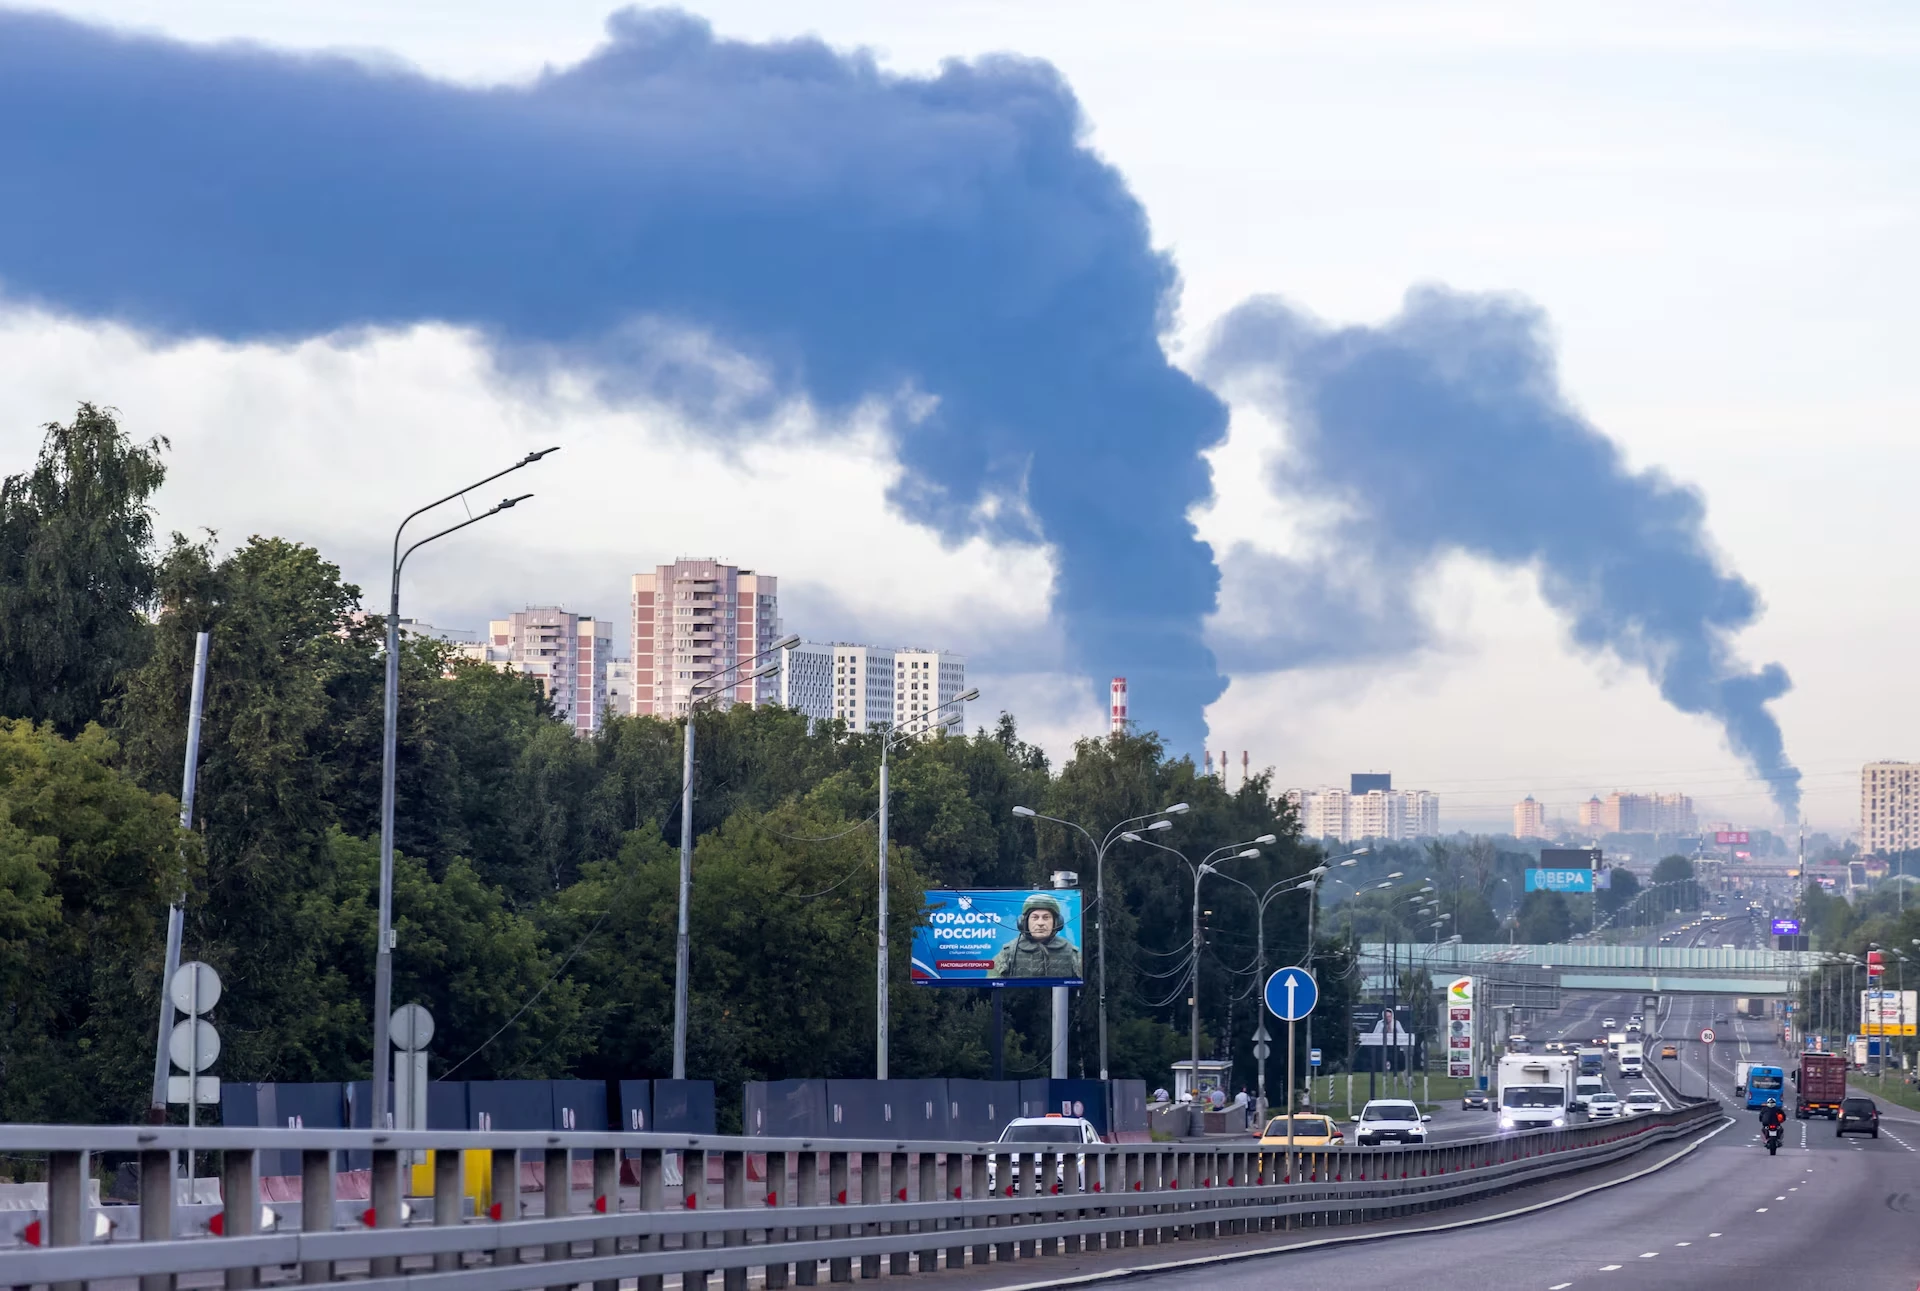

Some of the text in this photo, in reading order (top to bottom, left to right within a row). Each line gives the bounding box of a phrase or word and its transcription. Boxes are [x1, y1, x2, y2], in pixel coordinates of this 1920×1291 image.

[1547, 872, 1584, 884] ВЕРА
[929, 913, 1002, 925] ГОРДОСТЬ
[934, 928, 996, 939] РОССИИ!
